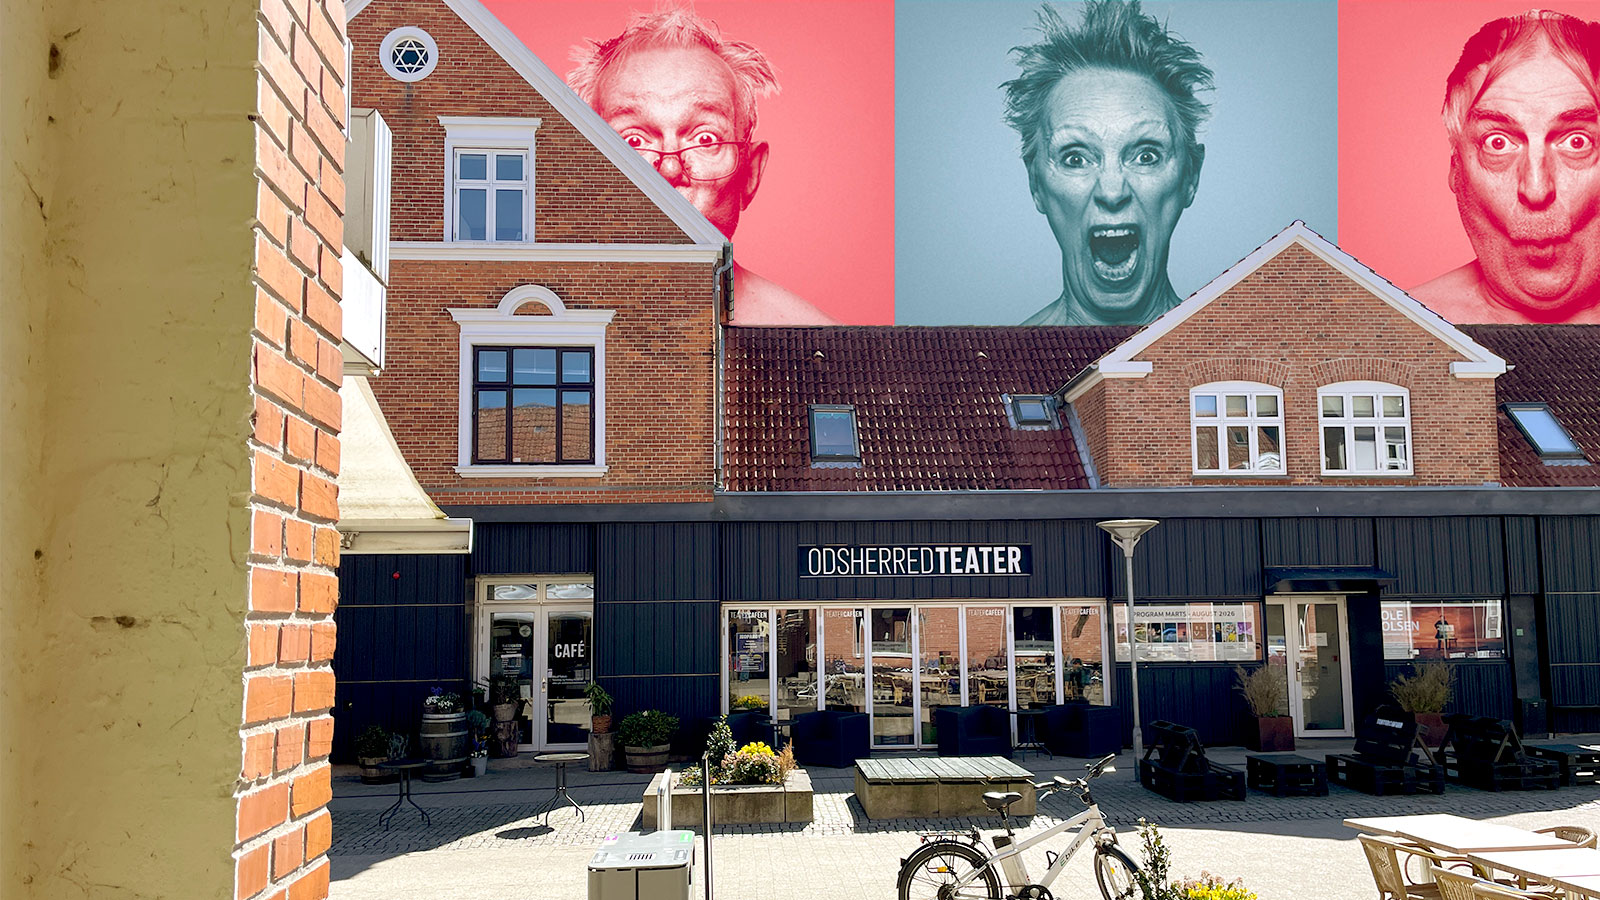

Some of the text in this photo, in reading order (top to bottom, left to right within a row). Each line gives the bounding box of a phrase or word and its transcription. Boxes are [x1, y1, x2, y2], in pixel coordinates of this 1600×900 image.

[808, 547, 1022, 575] ODSHERREDTEATER
[1381, 610, 1403, 620] OLE
[1382, 620, 1420, 631] OLSEN
[555, 640, 585, 658] CAFÉ
